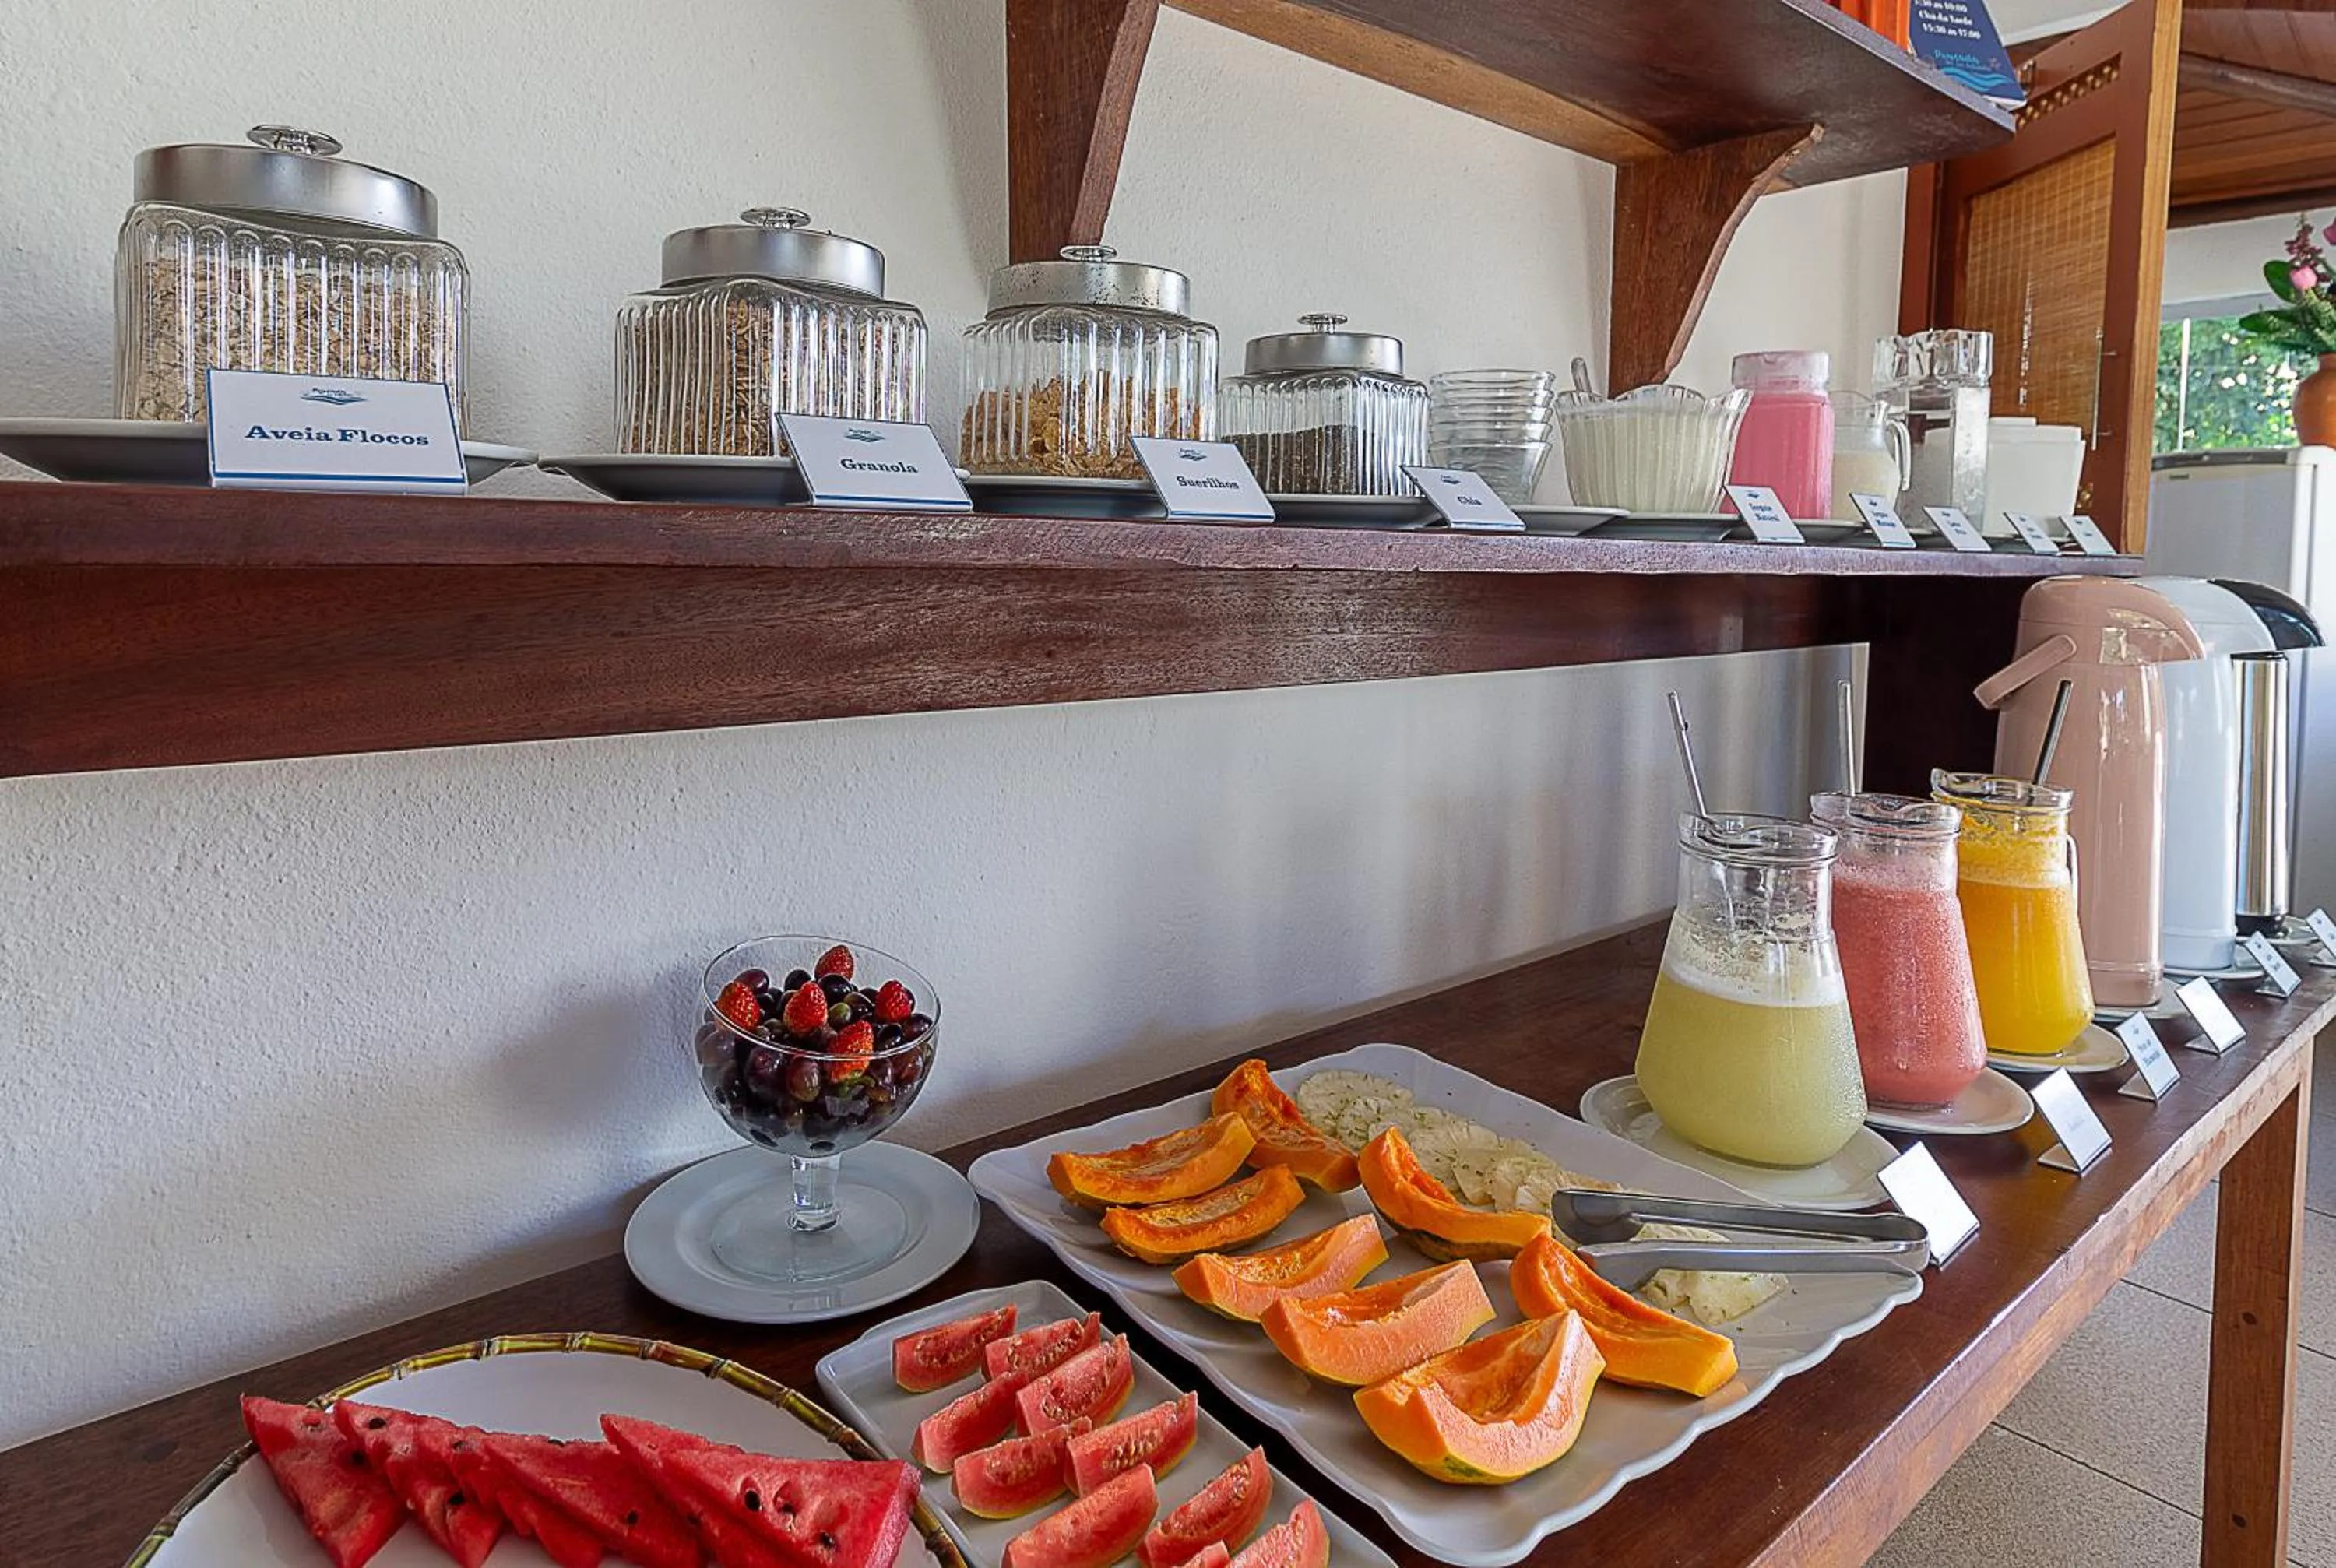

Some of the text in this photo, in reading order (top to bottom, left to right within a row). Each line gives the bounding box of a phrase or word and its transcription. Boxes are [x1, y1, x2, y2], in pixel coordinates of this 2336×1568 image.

[245, 425, 430, 445] Aveia Flocos
[840, 459, 919, 473] Granola
[1177, 476, 1239, 489] Sucrilhos
